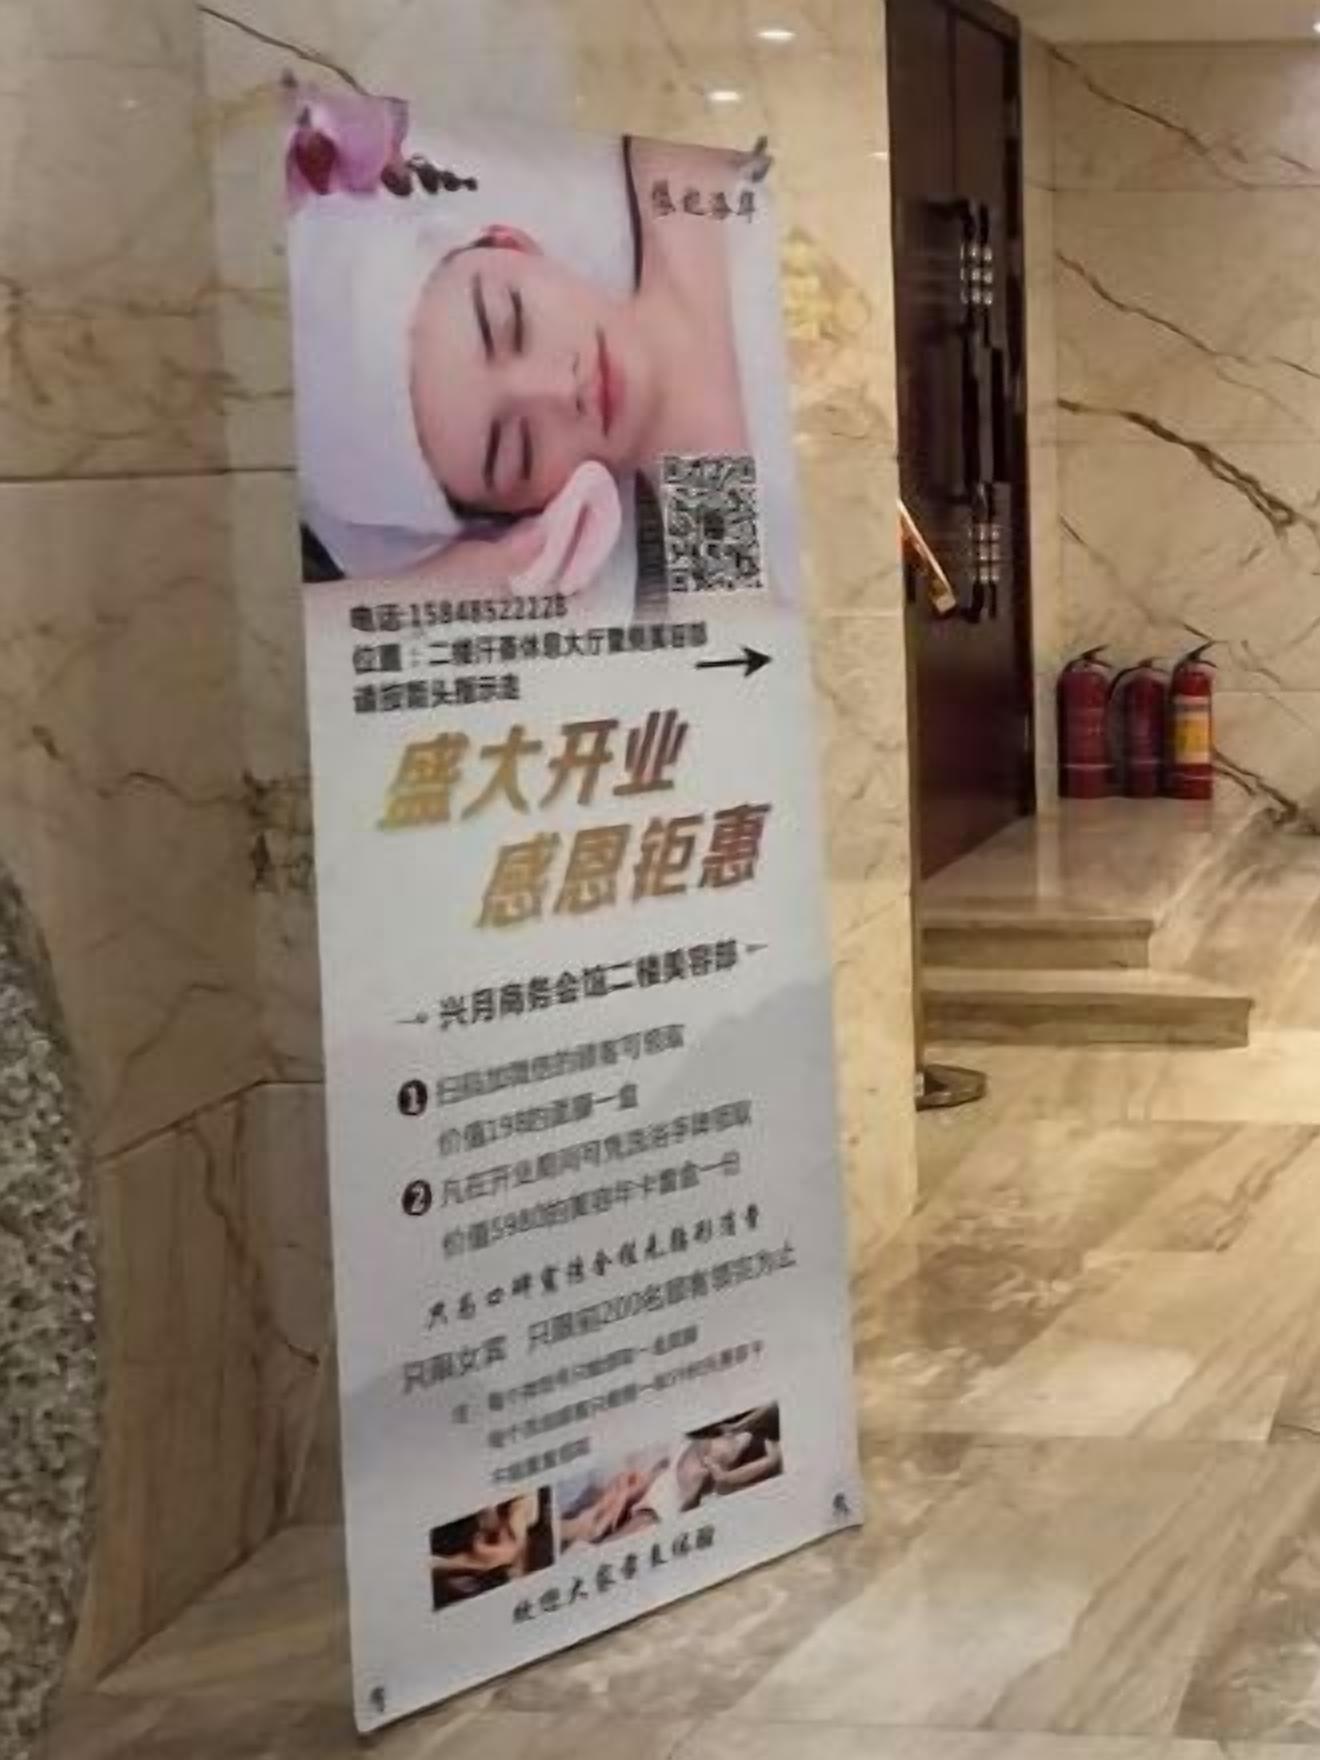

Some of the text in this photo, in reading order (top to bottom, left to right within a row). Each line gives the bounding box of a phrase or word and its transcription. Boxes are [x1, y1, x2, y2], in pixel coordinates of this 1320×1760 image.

[376, 707, 689, 831] 盛大开业
[475, 802, 771, 929] 感恩钜惠
